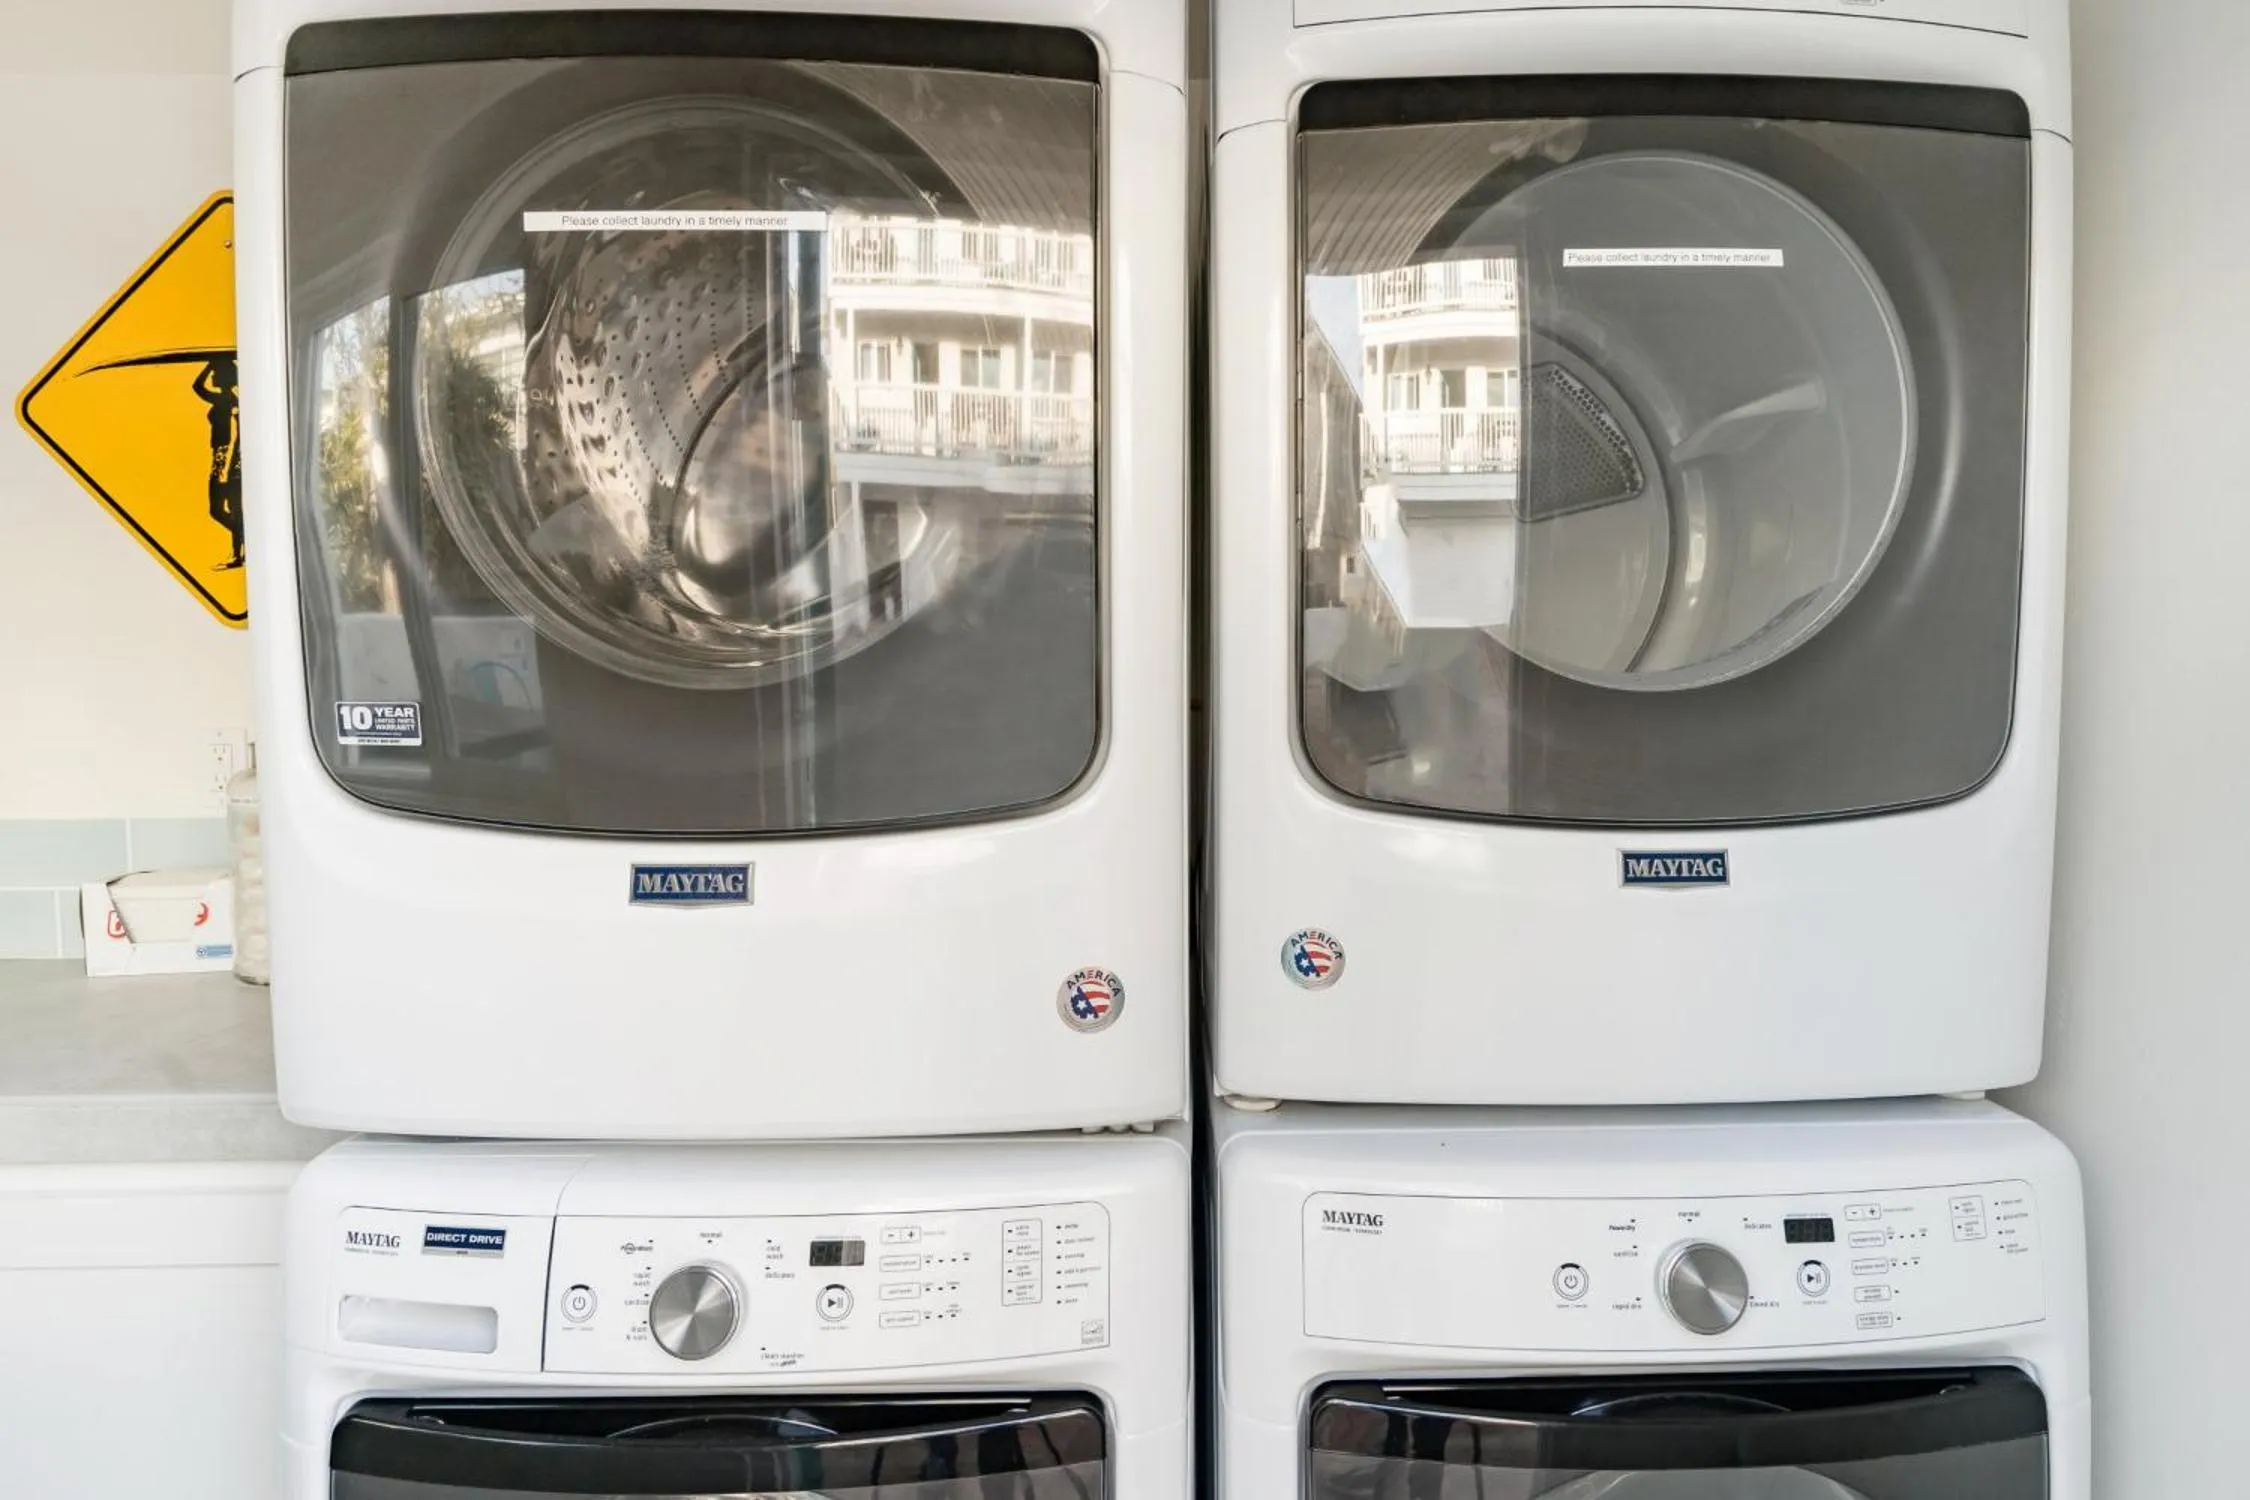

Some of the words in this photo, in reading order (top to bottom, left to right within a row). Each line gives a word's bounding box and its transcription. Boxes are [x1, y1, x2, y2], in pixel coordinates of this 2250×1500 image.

[561, 214, 599, 226] Please
[602, 214, 638, 226] collect
[641, 214, 682, 228] laundry
[685, 215, 695, 226] in
[698, 217, 706, 226] a
[709, 214, 741, 228] timely
[744, 217, 788, 226] manner
[1568, 252, 1602, 263] Please
[1605, 252, 1639, 263] collect
[1641, 252, 1678, 264] laundry
[1692, 254, 1698, 262] a
[1701, 252, 1730, 264] timely
[340, 706, 373, 730] 10
[374, 707, 414, 718] YEAR
[1626, 858, 1724, 878] MAYTAG
[636, 873, 745, 893] MAYTAG
[1291, 930, 1343, 960] AMERICA
[1066, 969, 1121, 997] AMERICA
[1322, 1210, 1384, 1227] MAYTAG
[345, 1231, 401, 1248] MAYTAG
[427, 1233, 466, 1242] DIRECT
[469, 1235, 503, 1245] DRIVE
